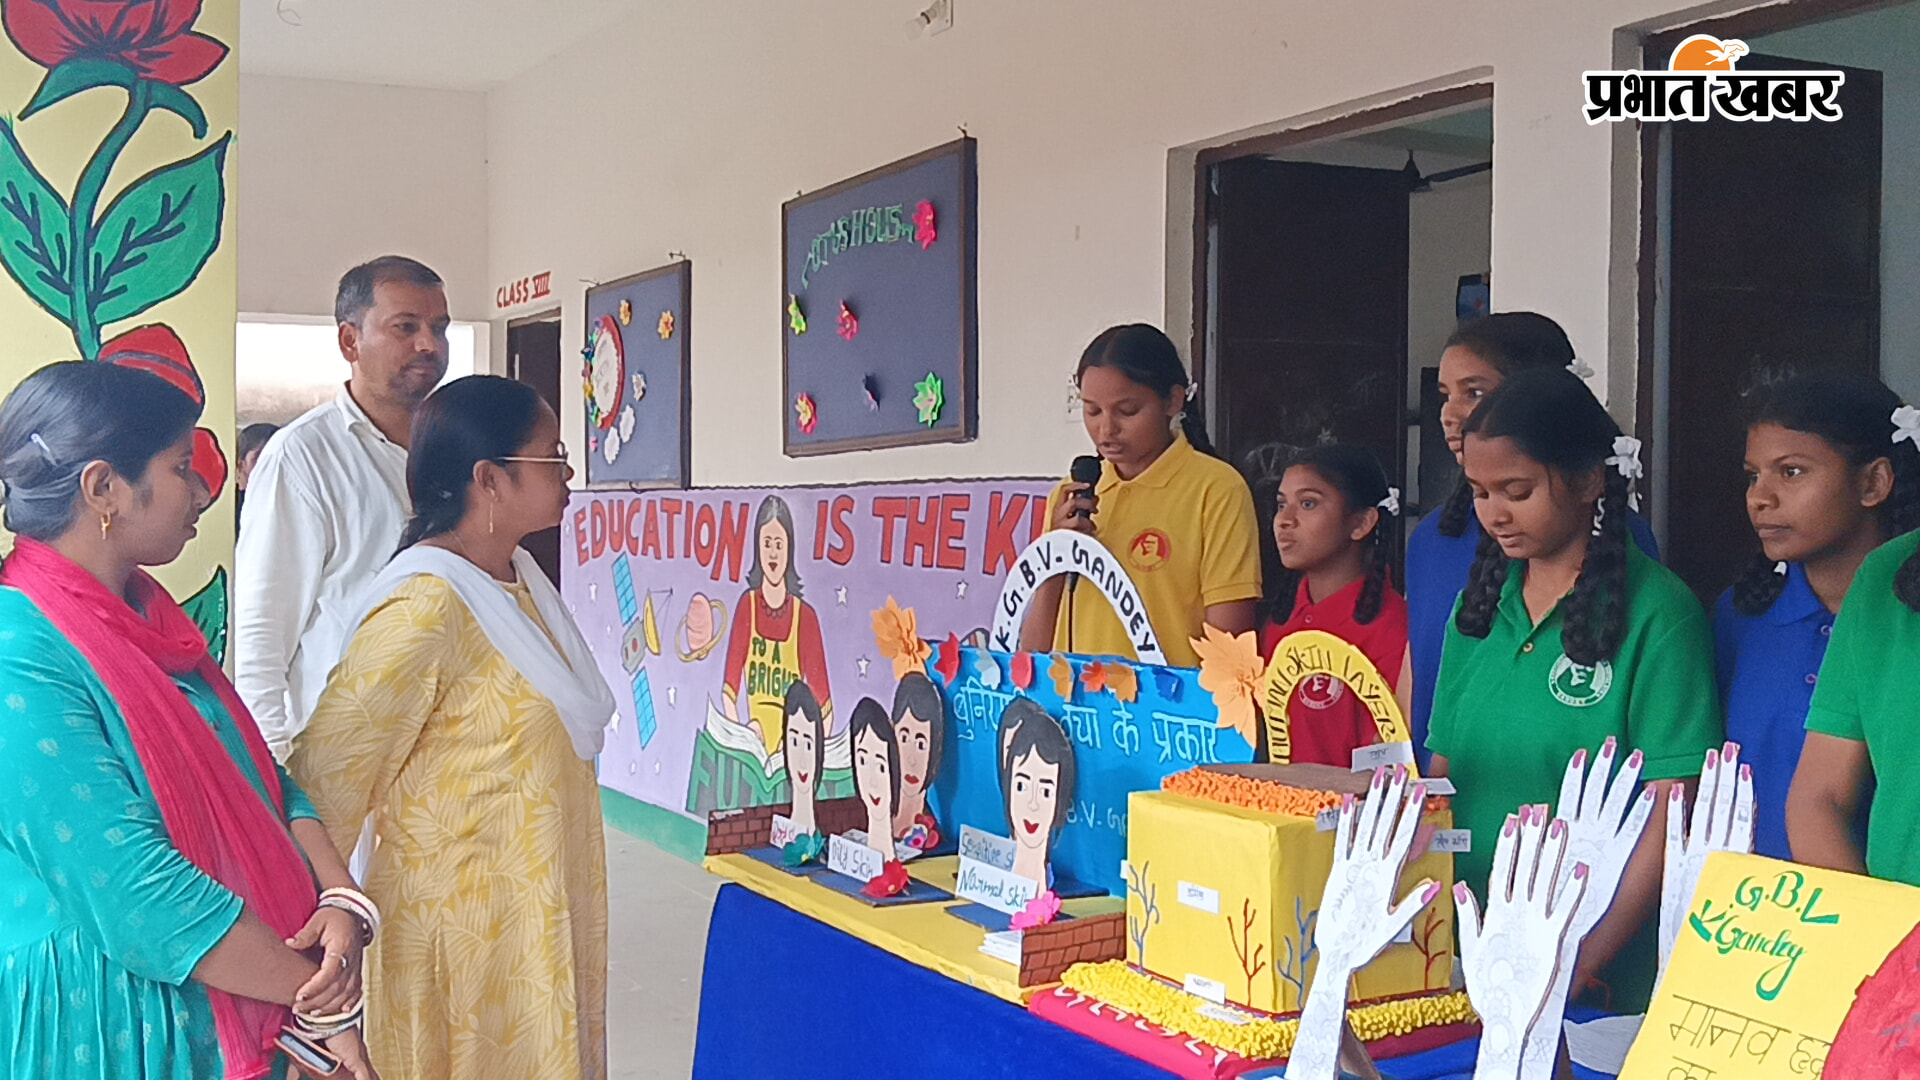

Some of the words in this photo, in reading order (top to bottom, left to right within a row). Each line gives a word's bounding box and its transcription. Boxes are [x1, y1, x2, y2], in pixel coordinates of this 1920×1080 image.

[496, 277, 529, 308] CLASS
[573, 497, 750, 583] EDUCATION
[813, 495, 855, 566] IS
[872, 493, 970, 570] THE
[1072, 540, 1156, 652] GANDEY
[752, 637, 767, 657] TO
[771, 640, 781, 665] A
[1112, 699, 1140, 756] के
[1151, 711, 1220, 764] प्रकार
[1669, 994, 1792, 1064] मानव
